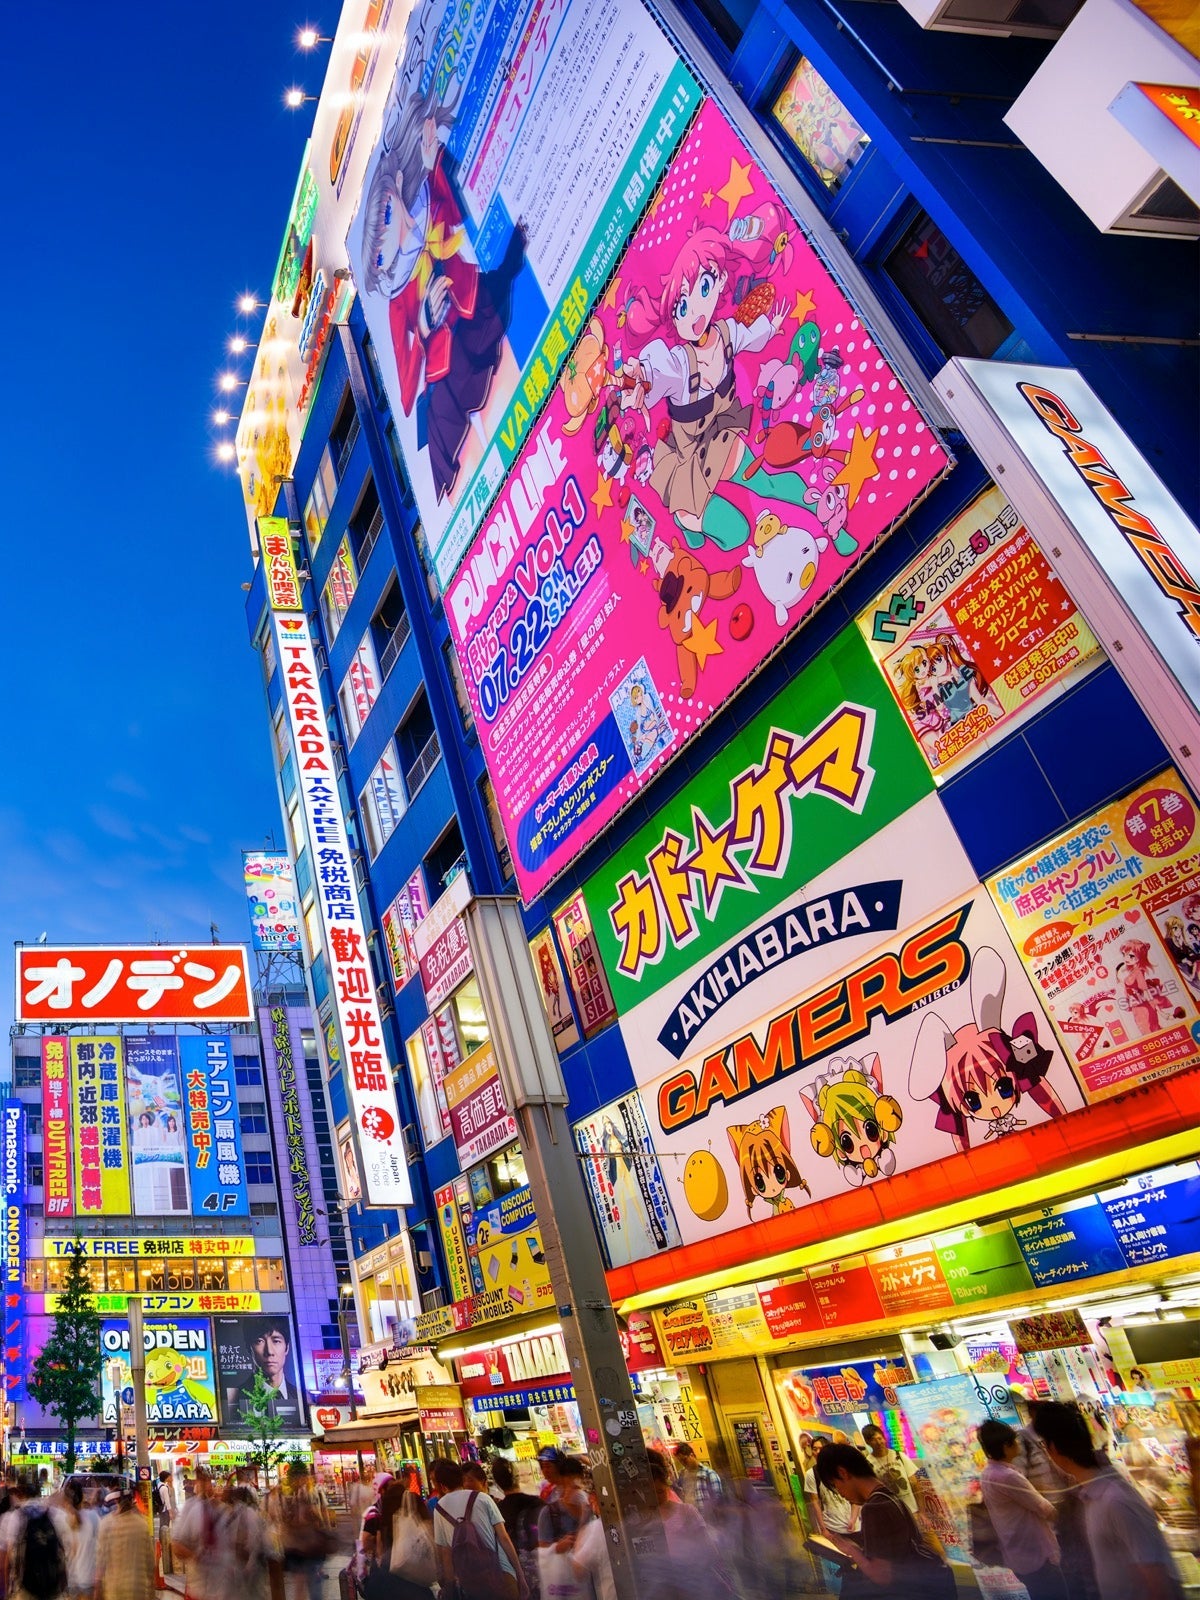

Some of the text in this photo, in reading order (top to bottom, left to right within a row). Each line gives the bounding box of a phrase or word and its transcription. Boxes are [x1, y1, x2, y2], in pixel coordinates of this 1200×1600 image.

[622, 84, 691, 213] 開催中!!
[603, 205, 624, 239] 2015
[449, 422, 569, 642] PUNCH LINE
[925, 504, 1021, 602] 2015年5月号
[265, 535, 299, 607] まんが喫茶
[541, 560, 567, 604] ON
[954, 541, 1041, 627] 魔法少女リリカル
[972, 565, 1040, 630] なのはViVid
[986, 584, 1043, 640] オリジナル
[994, 598, 1052, 652] ブロマイド
[472, 635, 500, 686] DVD
[479, 599, 551, 722] 07.22
[1004, 622, 1080, 690] 好評発売中!!
[284, 646, 330, 771] TAKARADA
[913, 662, 977, 723] SAMPLE
[1125, 792, 1184, 837] 第7巻
[1149, 818, 1176, 840] 好評
[996, 822, 1113, 900] 俺がお嬢様学校に
[316, 847, 356, 921] 免税商店
[1042, 855, 1144, 921] として拉致られた件
[23, 951, 242, 1011] オノデン
[676, 890, 872, 1042] AKIHABARA
[658, 898, 977, 1136] GAMERS
[910, 978, 962, 1012] ANIBRO
[1117, 980, 1179, 1012] SAMPLE
[45, 1041, 65, 1080] 免税
[187, 1069, 213, 1169] 大特売中!!
[206, 1041, 241, 1185] エアコン扇風機
[6, 1107, 20, 1194] Panasonic
[47, 1120, 68, 1198] DUTYFREE
[474, 1123, 512, 1164] TAKARADA
[47, 1197, 70, 1213] B1F
[202, 1193, 237, 1211] 4F
[438, 1188, 454, 1205] 2F
[501, 1189, 532, 1213] DISCOUN
[1138, 1176, 1155, 1190] 6F
[7, 1205, 21, 1282] ONODEN
[52, 1241, 90, 1255] TAX
[93, 1240, 140, 1255] FREE
[144, 1240, 185, 1254] 免税店
[479, 1229, 490, 1246] 2F
[894, 1246, 903, 1258] 3F
[943, 1249, 957, 1262] CD
[963, 1229, 975, 1241] 4F
[831, 1263, 840, 1273] 2F
[950, 1266, 970, 1279] DVD
[143, 1296, 195, 1310] エアコン
[471, 1288, 504, 1311] DISCOUNT
[484, 1300, 515, 1321] MOBILES
[220, 1345, 240, 1353] 教えて
[220, 1354, 250, 1363] あげたい
[620, 1411, 635, 1420] JS
[620, 1419, 638, 1427] ONE
[680, 1386, 703, 1439] TAX
